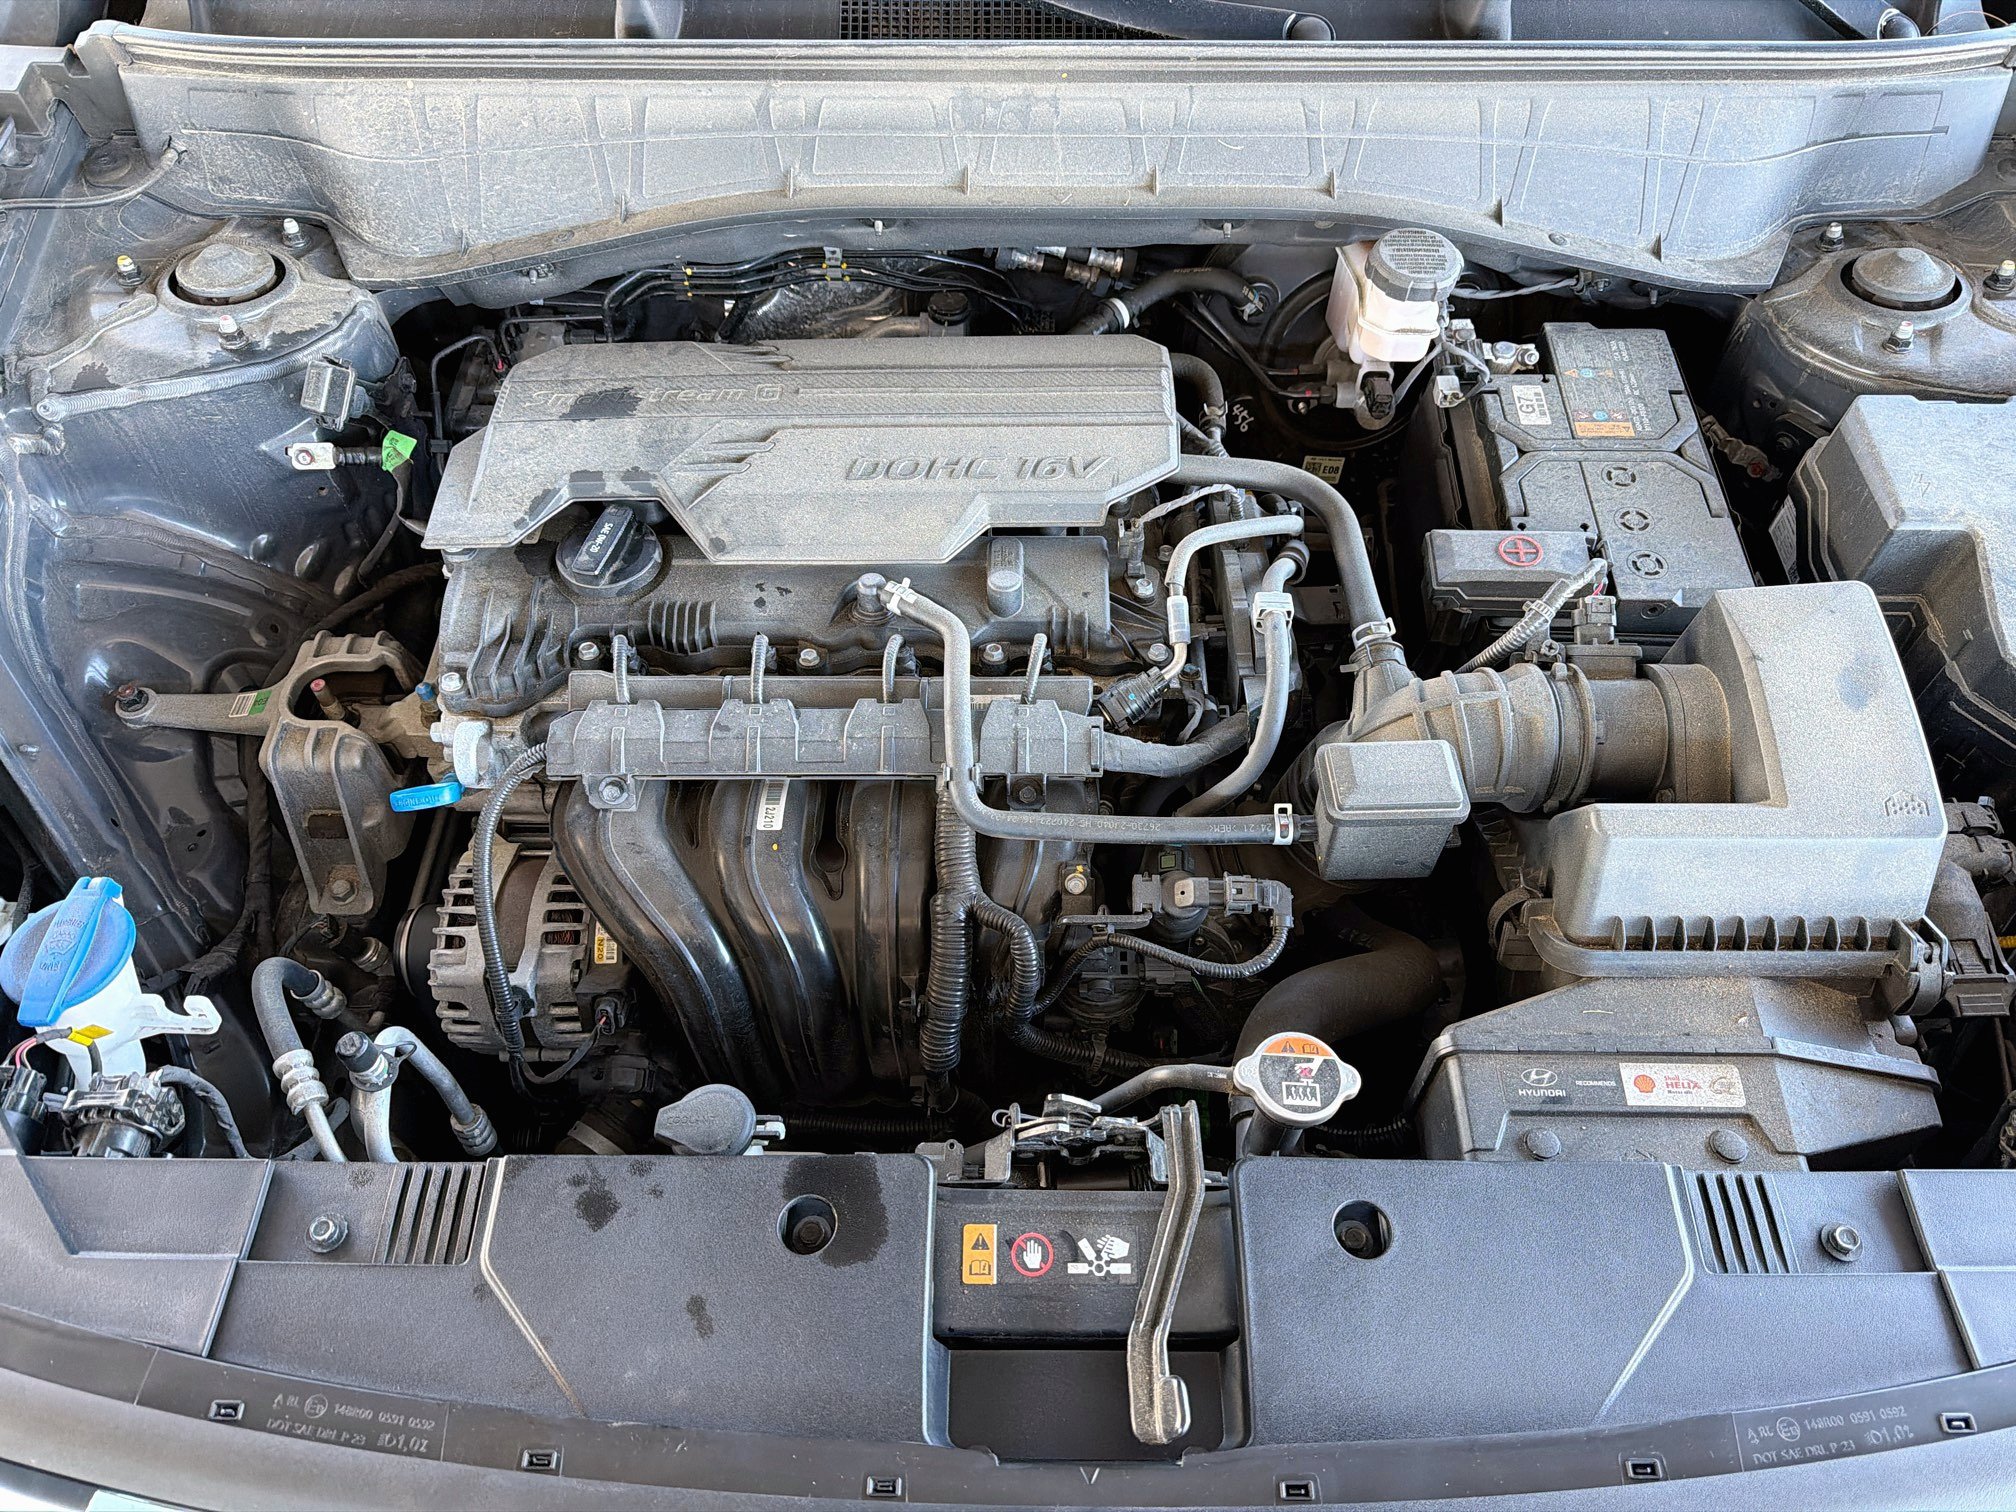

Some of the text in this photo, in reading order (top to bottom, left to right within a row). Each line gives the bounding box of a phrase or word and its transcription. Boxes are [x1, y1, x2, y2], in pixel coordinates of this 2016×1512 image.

[1518, 396, 1537, 414] G7
[847, 456, 1113, 480] DOHC 16V
[590, 522, 614, 553] SAE 0W-20
[763, 807, 776, 829] 2J210
[1518, 1088, 1567, 1097] HYUNDAI
[1665, 1081, 1704, 1090] HELIX
